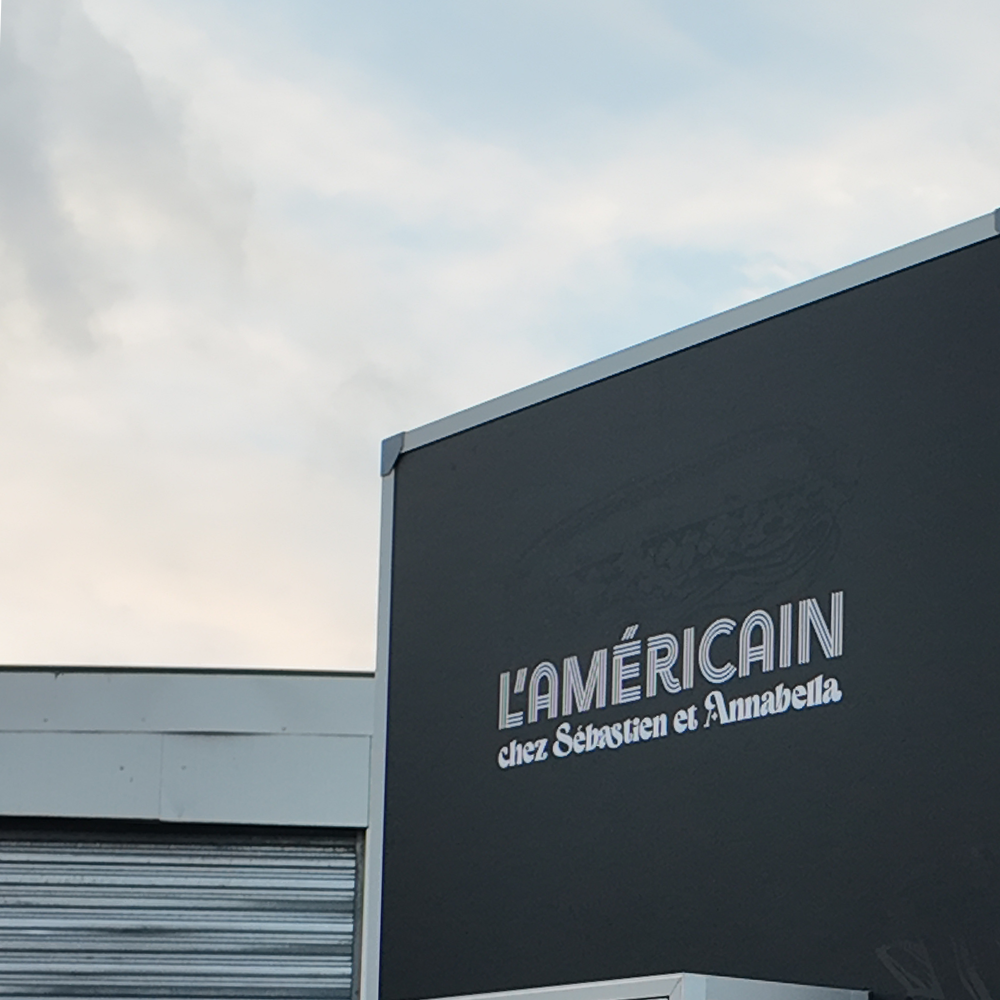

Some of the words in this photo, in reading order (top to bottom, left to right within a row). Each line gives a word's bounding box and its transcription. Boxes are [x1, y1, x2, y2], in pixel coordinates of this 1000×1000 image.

[498, 591, 844, 730] L'AMÉRICAIN
[498, 737, 548, 769] chez
[552, 711, 668, 758] Sébastien
[673, 705, 698, 733] et
[704, 674, 843, 728] Annabella
